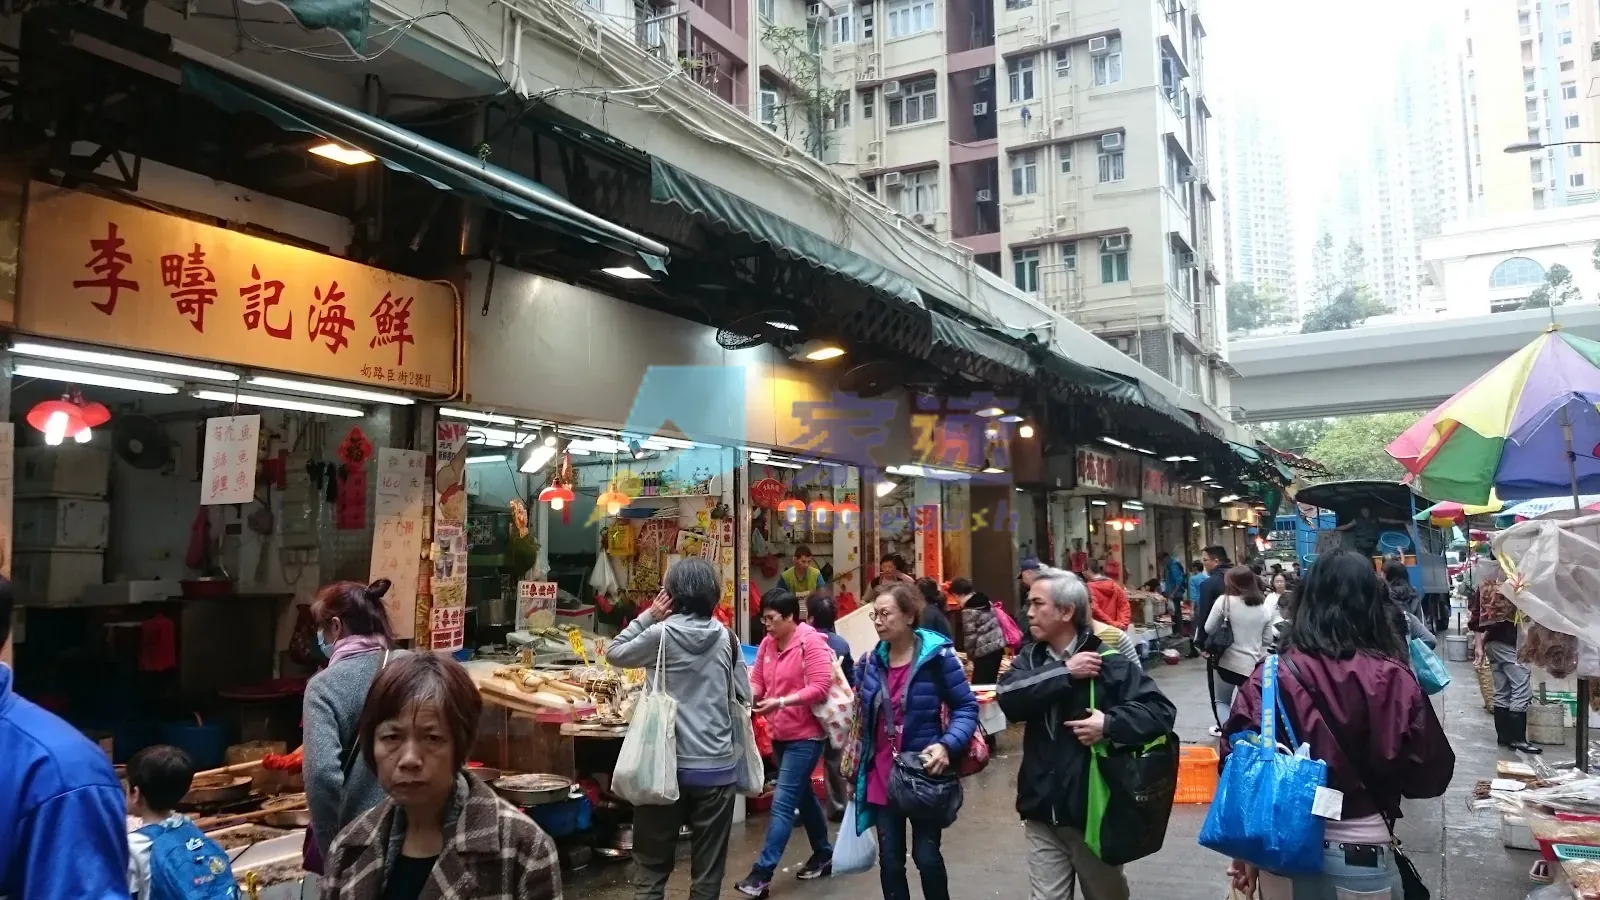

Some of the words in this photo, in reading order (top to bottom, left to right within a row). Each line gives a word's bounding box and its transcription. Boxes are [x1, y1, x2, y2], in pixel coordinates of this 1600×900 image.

[73, 222, 415, 365] 李疇記海鮮
[360, 364, 431, 388] 奶路臣街2號H
